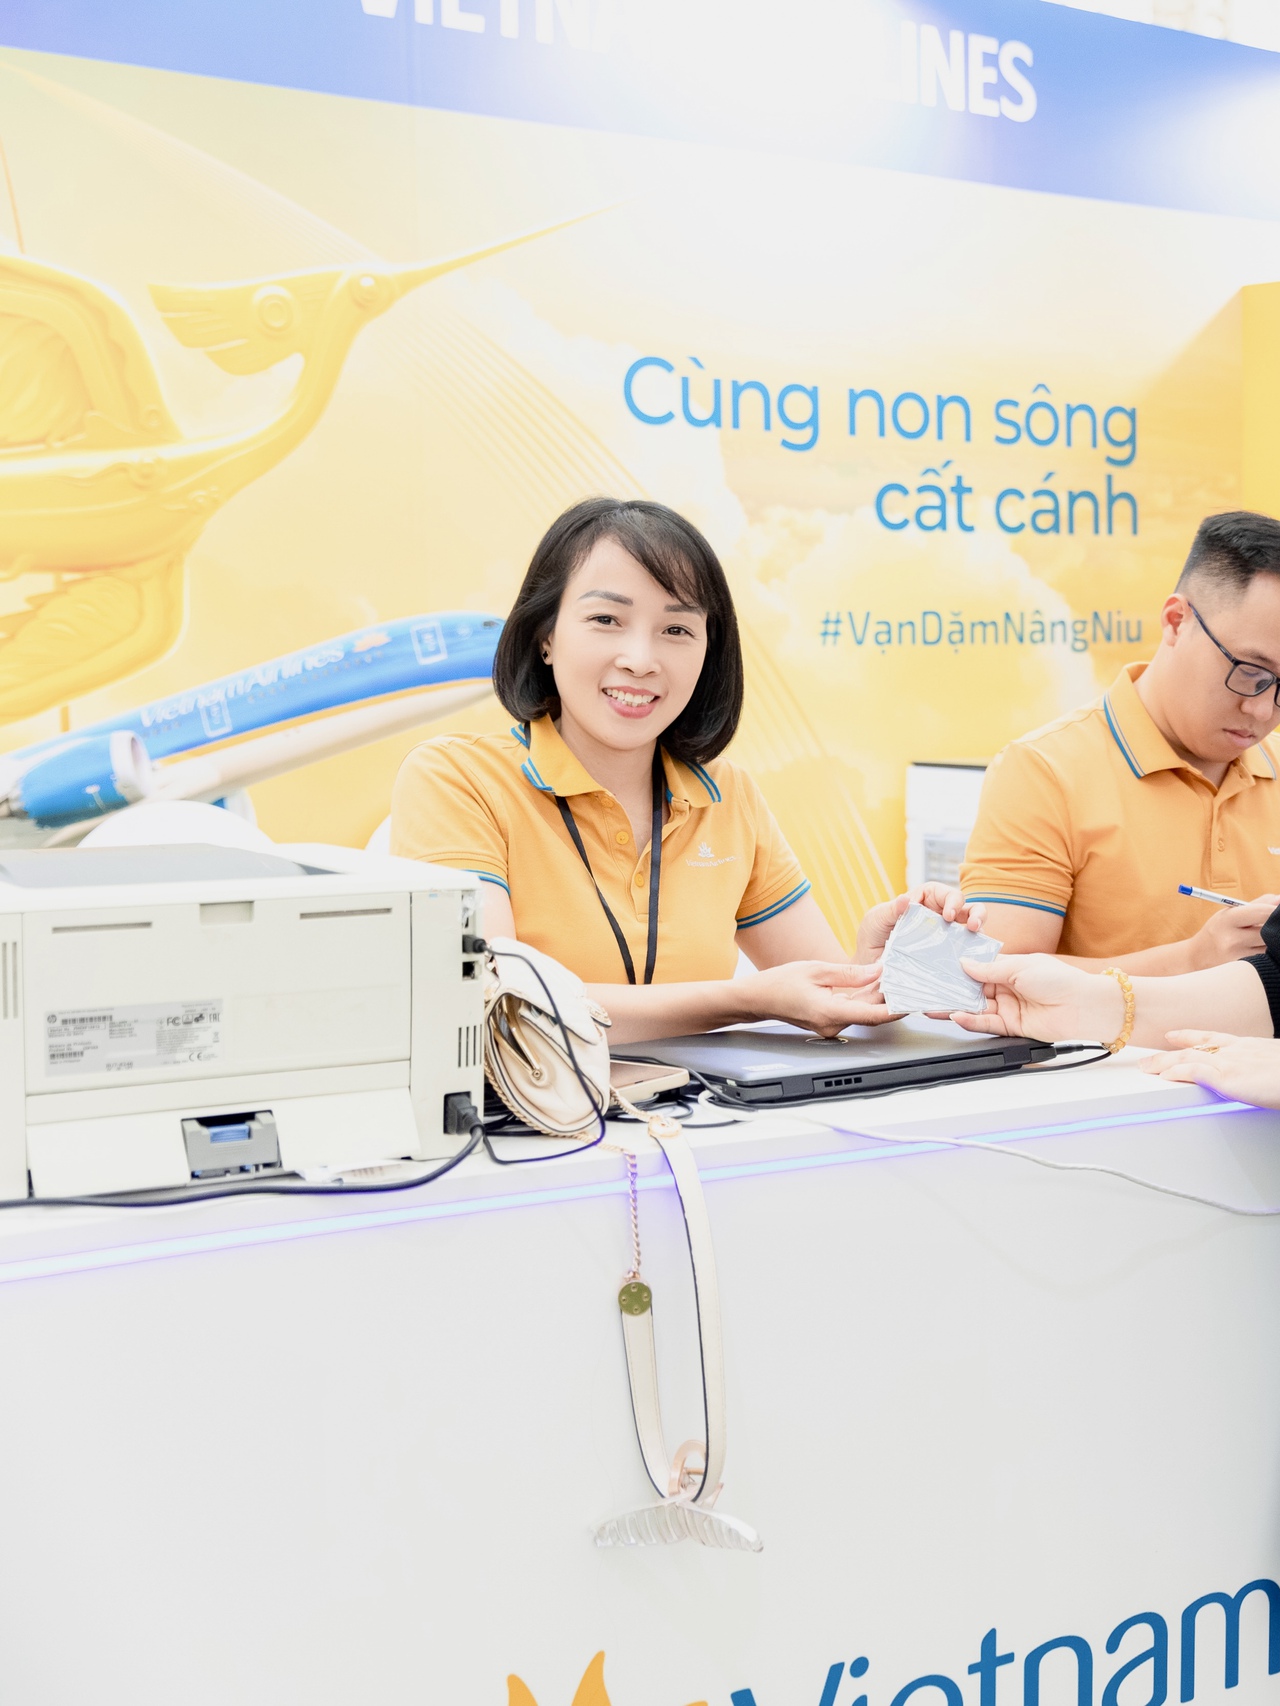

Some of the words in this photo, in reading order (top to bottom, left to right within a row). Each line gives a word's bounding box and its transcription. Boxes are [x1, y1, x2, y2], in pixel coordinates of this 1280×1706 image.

[623, 356, 819, 451] Cùng
[847, 388, 973, 441] non
[994, 383, 1137, 466] sông
[875, 459, 974, 532] cất
[994, 472, 1138, 536] cánh
[819, 609, 1143, 655] #VạnDặmNângNiu
